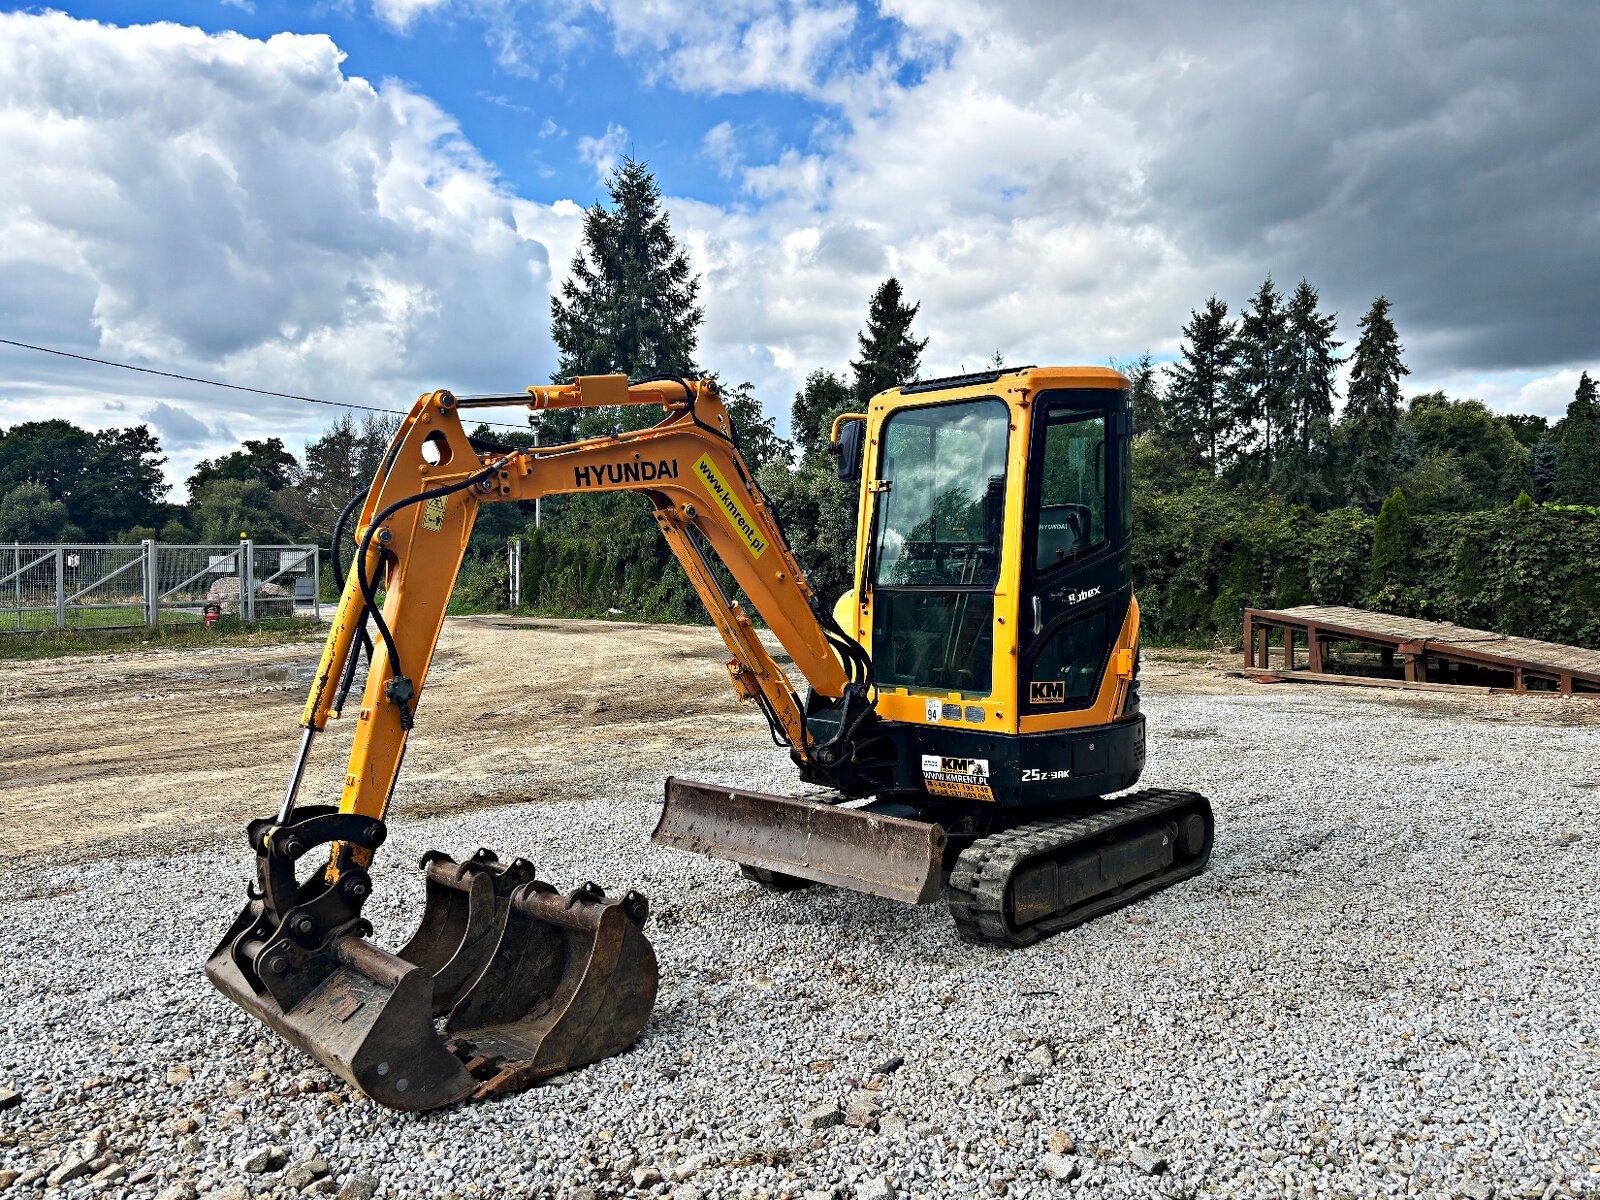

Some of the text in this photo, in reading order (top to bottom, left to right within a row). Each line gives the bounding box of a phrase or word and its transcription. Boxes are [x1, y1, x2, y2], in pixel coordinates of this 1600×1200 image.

[574, 459, 679, 487] HYUNDAI
[699, 460, 765, 553] www.kmrent.pl
[1031, 682, 1063, 698] KM
[927, 709, 937, 721] 94
[941, 757, 968, 771] KM
[922, 771, 989, 786] WWW.KMRENT.PL
